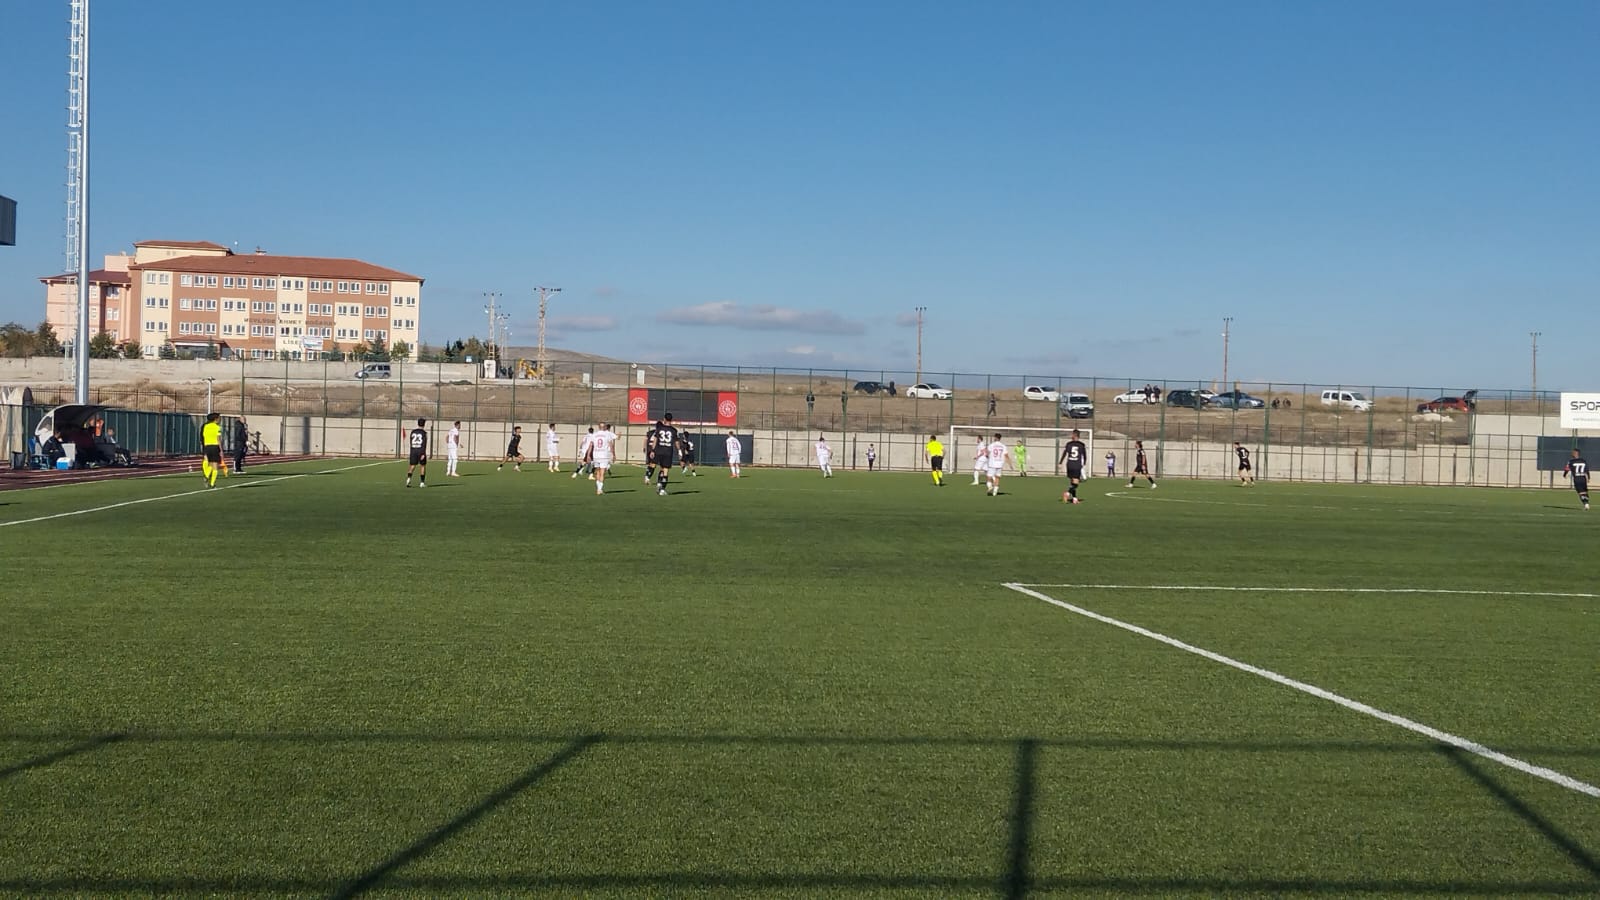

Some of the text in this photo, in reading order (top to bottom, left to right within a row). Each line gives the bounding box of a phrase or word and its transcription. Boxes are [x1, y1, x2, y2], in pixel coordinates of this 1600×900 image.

[411, 432, 423, 445] 23
[659, 430, 672, 443] 33
[993, 448, 1004, 458] 97
[1071, 446, 1079, 458] 5
[1572, 462, 1586, 474] 77
